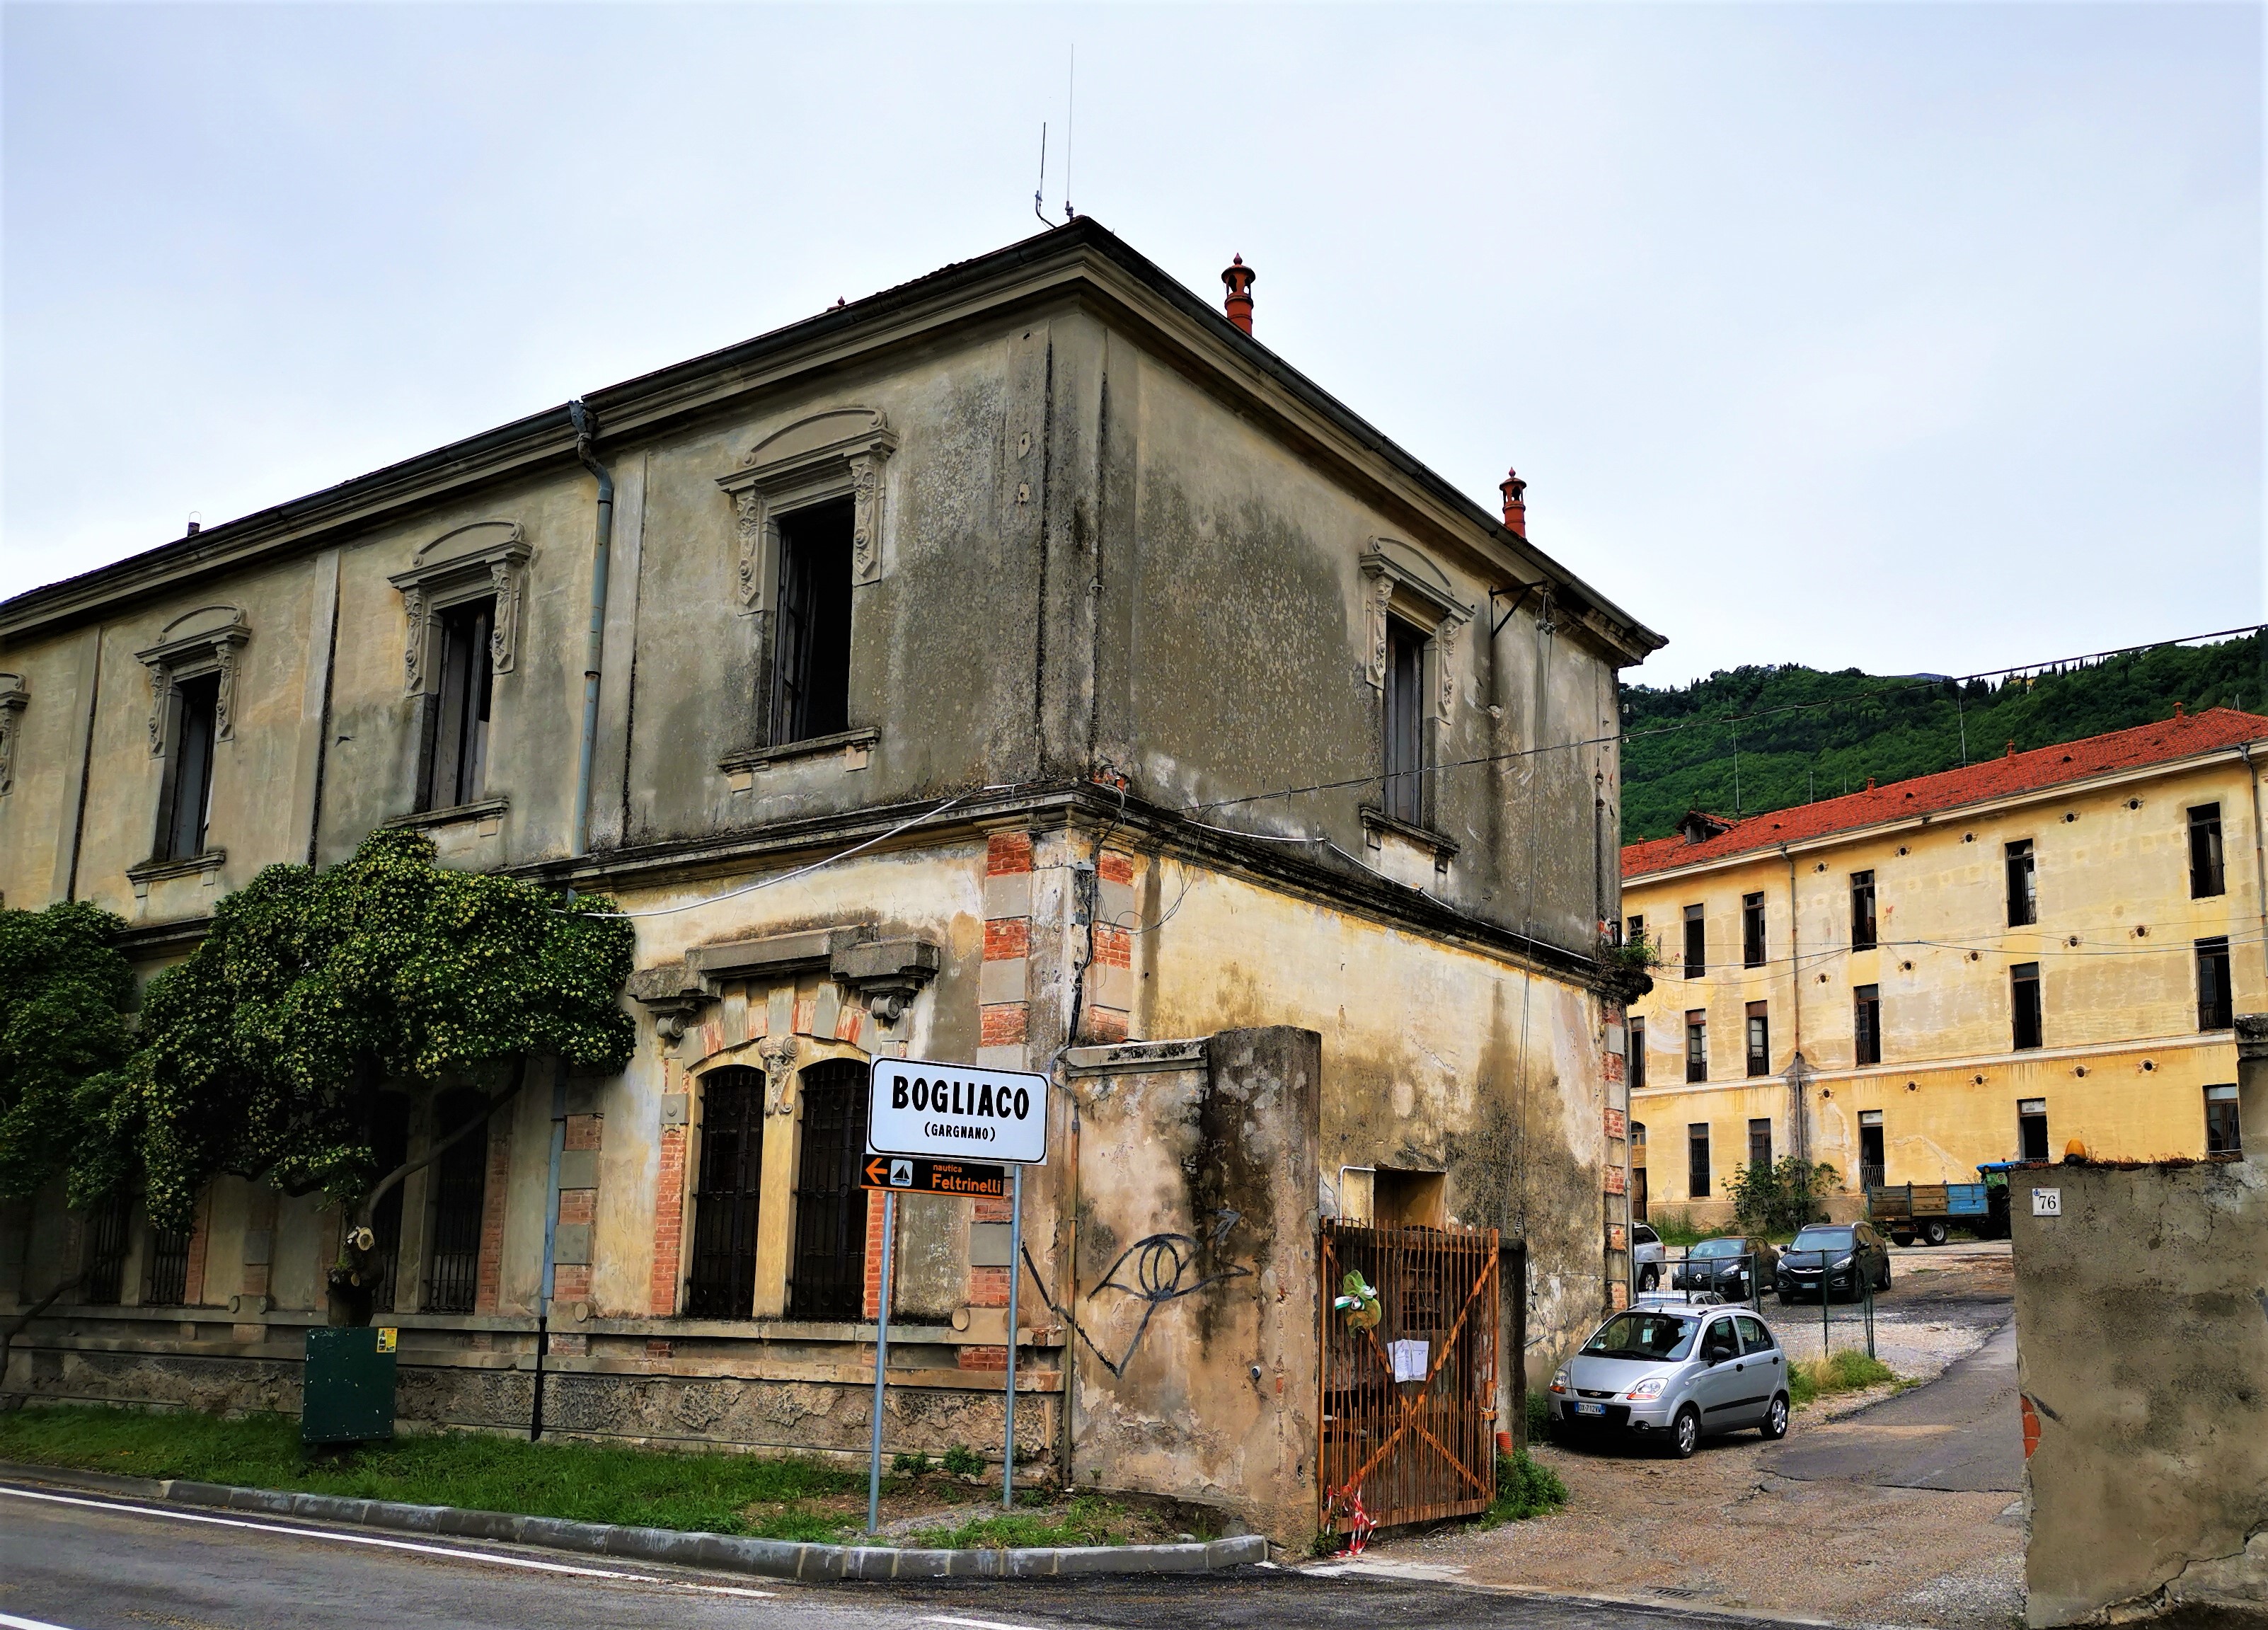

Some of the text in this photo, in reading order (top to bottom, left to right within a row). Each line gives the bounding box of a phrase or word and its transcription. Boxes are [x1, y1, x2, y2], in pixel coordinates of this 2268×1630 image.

[892, 1075, 1029, 1120] BOGLIACO
[924, 1122, 996, 1142] (GARGNANO)
[933, 1164, 962, 1173] nautica
[932, 1173, 1001, 1194] Feltrinelli
[2039, 1195, 2056, 1209] 76
